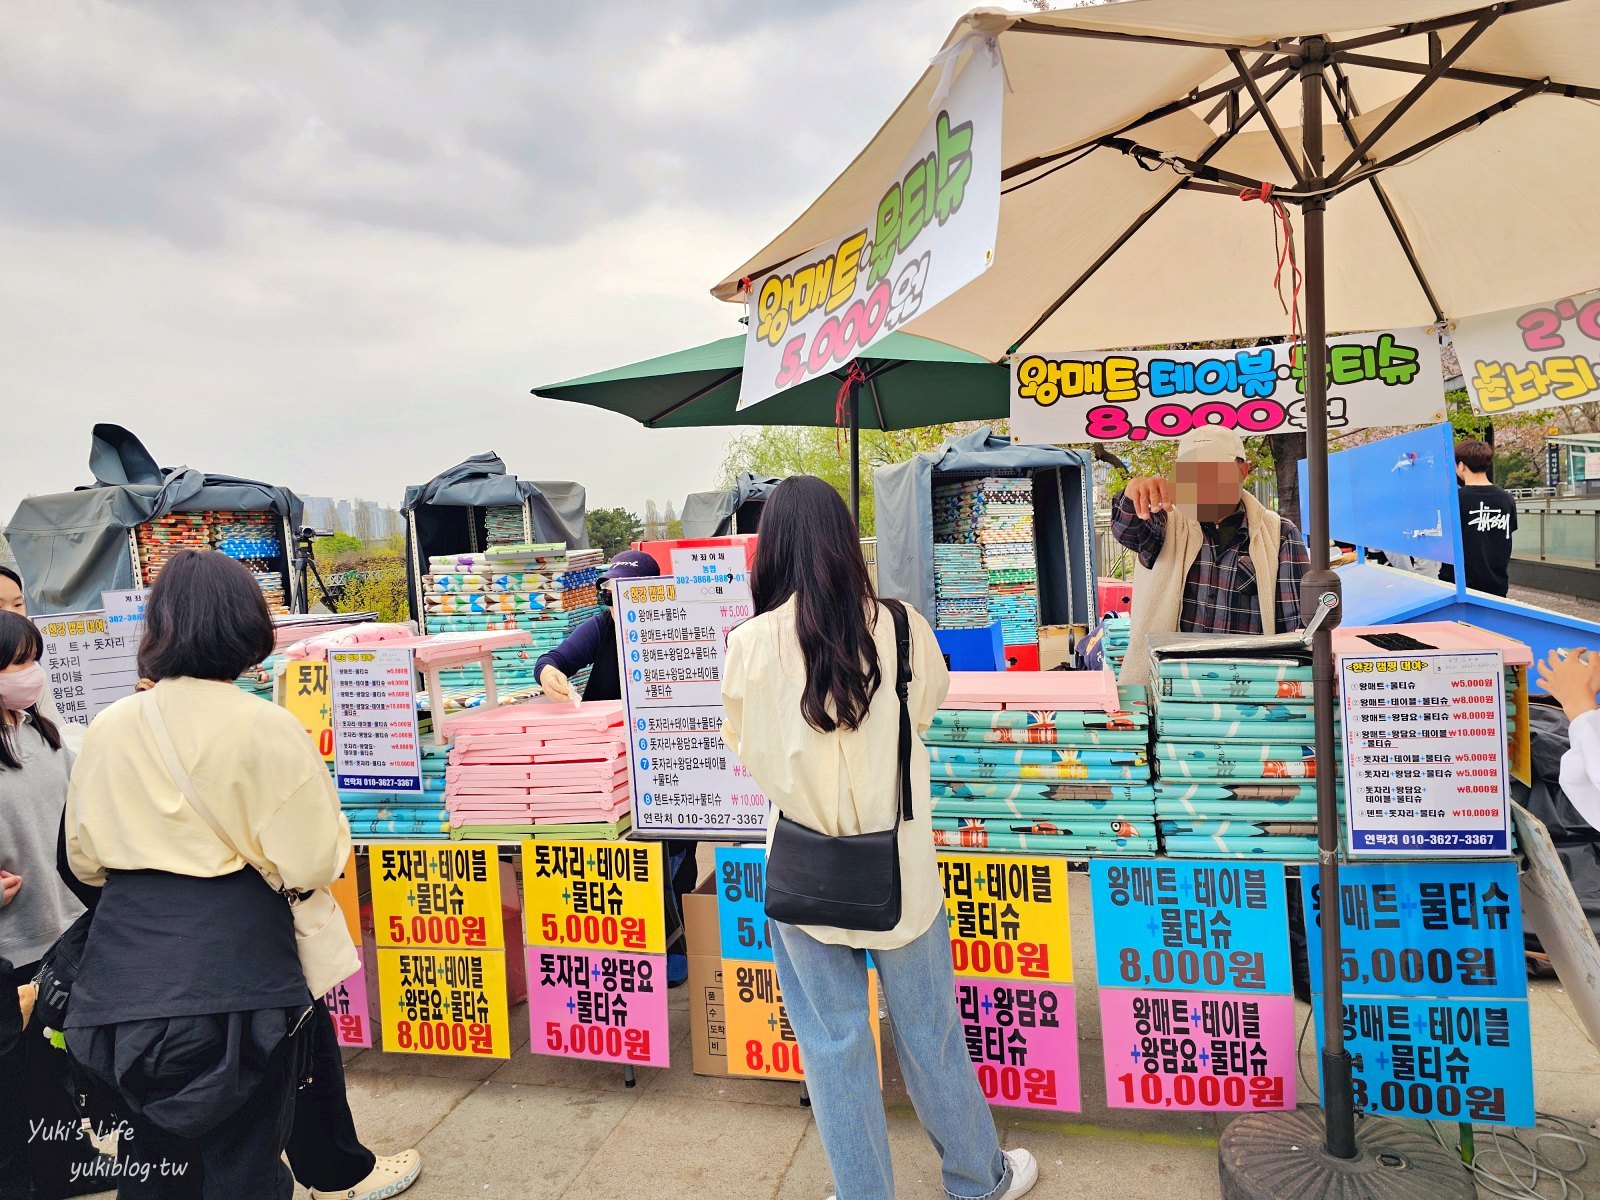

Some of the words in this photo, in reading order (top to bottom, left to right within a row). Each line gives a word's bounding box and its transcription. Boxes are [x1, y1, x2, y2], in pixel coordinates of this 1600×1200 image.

[775, 250, 931, 389] 5,000원
[1085, 398, 1349, 441] 8,000원
[666, 584, 676, 601] 대
[638, 608, 687, 623] 왕매트+물티슈
[94, 636, 125, 651] 돗자리
[640, 627, 716, 643] 왕매트+테이블+물티슈
[49, 656, 80, 670] 돗자리
[642, 647, 718, 662] 왕매트+왕담요+물티슈
[51, 671, 83, 685] 테이블
[298, 665, 329, 697] 돗자
[644, 667, 719, 682] 왕매트+왕담요+테이블
[645, 684, 672, 698] +물티슈
[53, 685, 85, 700] 왕담요
[56, 700, 87, 714] 왕매트
[63, 714, 89, 726] 자리
[648, 717, 723, 731] 돗자리+테이블+물티슈
[650, 736, 725, 750] 돗자리+왕담요+물티슈
[651, 757, 727, 771] 돗자리+왕담요+테이블
[653, 773, 680, 787] +물티슈
[654, 793, 722, 806] 텐트+돗자리+물티슈
[643, 813, 673, 825] 연락처
[678, 813, 764, 825] 010-3627-3367
[1402, 834, 1494, 845] 010-3627-3367
[381, 849, 488, 882] 돗자리+테이블
[535, 845, 649, 882] 돗자리+테이블
[722, 860, 764, 902] 왕매
[937, 861, 1052, 904] 자리+테이블
[1107, 866, 1267, 909] 왕매트+테이블
[407, 883, 464, 915] +물티슈
[562, 881, 623, 916] +물티슈
[389, 915, 487, 947] 5,000원
[541, 913, 647, 949] 5,000원
[946, 901, 1020, 941] +물티슈
[1147, 908, 1232, 950] +물티슈
[399, 955, 484, 989] 돗자리+테이블
[540, 953, 654, 993] 돗자리+왕담요
[950, 938, 1050, 979] 000원
[1119, 947, 1266, 990] 8,000원
[1341, 947, 1498, 986] 5,000원
[737, 966, 784, 1004] 왕매
[398, 989, 489, 1024] +왕담요+물티슈
[566, 990, 628, 1027] +물티슈
[709, 1008, 716, 1018] 수
[954, 985, 1060, 1028] 리+왕담요
[1132, 997, 1261, 1039] 왕매트+테이블
[397, 1020, 493, 1054] 8,000원
[546, 1021, 651, 1062] 5,000원
[710, 1025, 725, 1035] 도착
[711, 1042, 719, 1051] 비
[963, 1027, 1028, 1067] 물티슈
[1131, 1037, 1268, 1077] +왕담요+물티슈
[1375, 1044, 1470, 1084] +물티슈
[978, 1065, 1058, 1106] 00원
[1118, 1073, 1284, 1108] 10,000원
[369, 1176, 410, 1200] crocs
